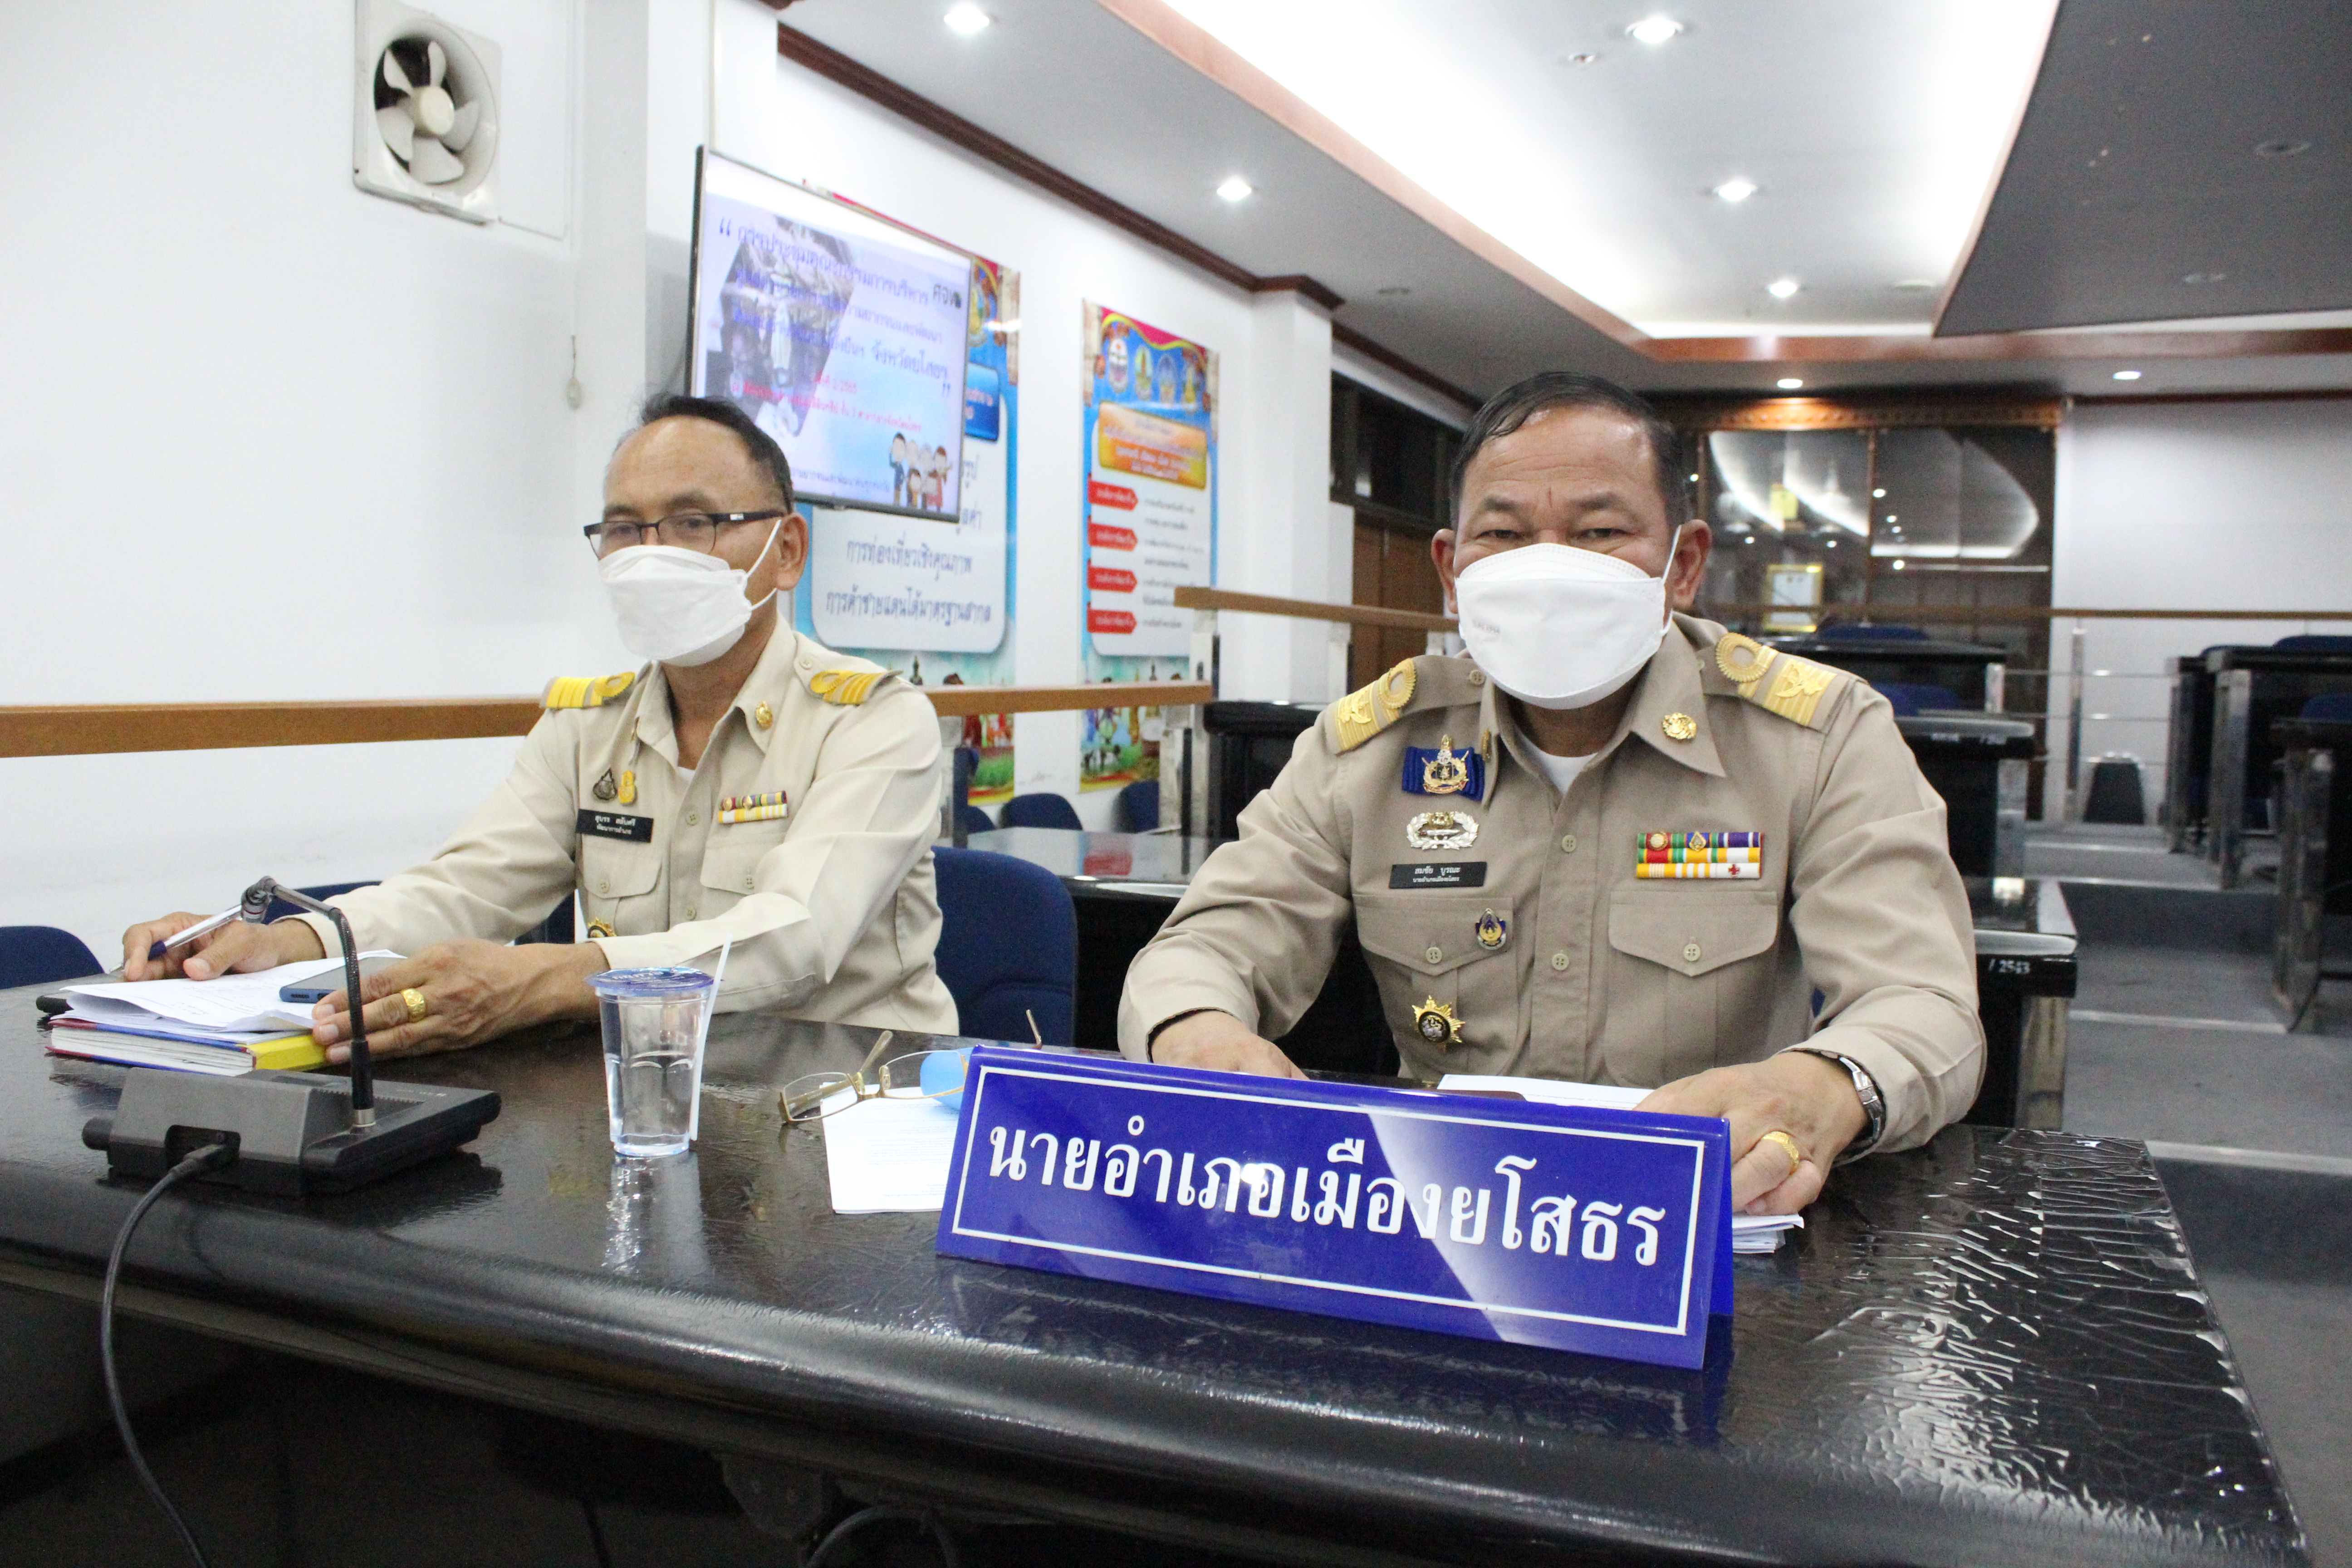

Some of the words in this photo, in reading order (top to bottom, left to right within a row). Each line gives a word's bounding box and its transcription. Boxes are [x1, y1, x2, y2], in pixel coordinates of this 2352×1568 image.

[990, 1115, 1666, 1266] นายอำเภอเมืองยโสธร
